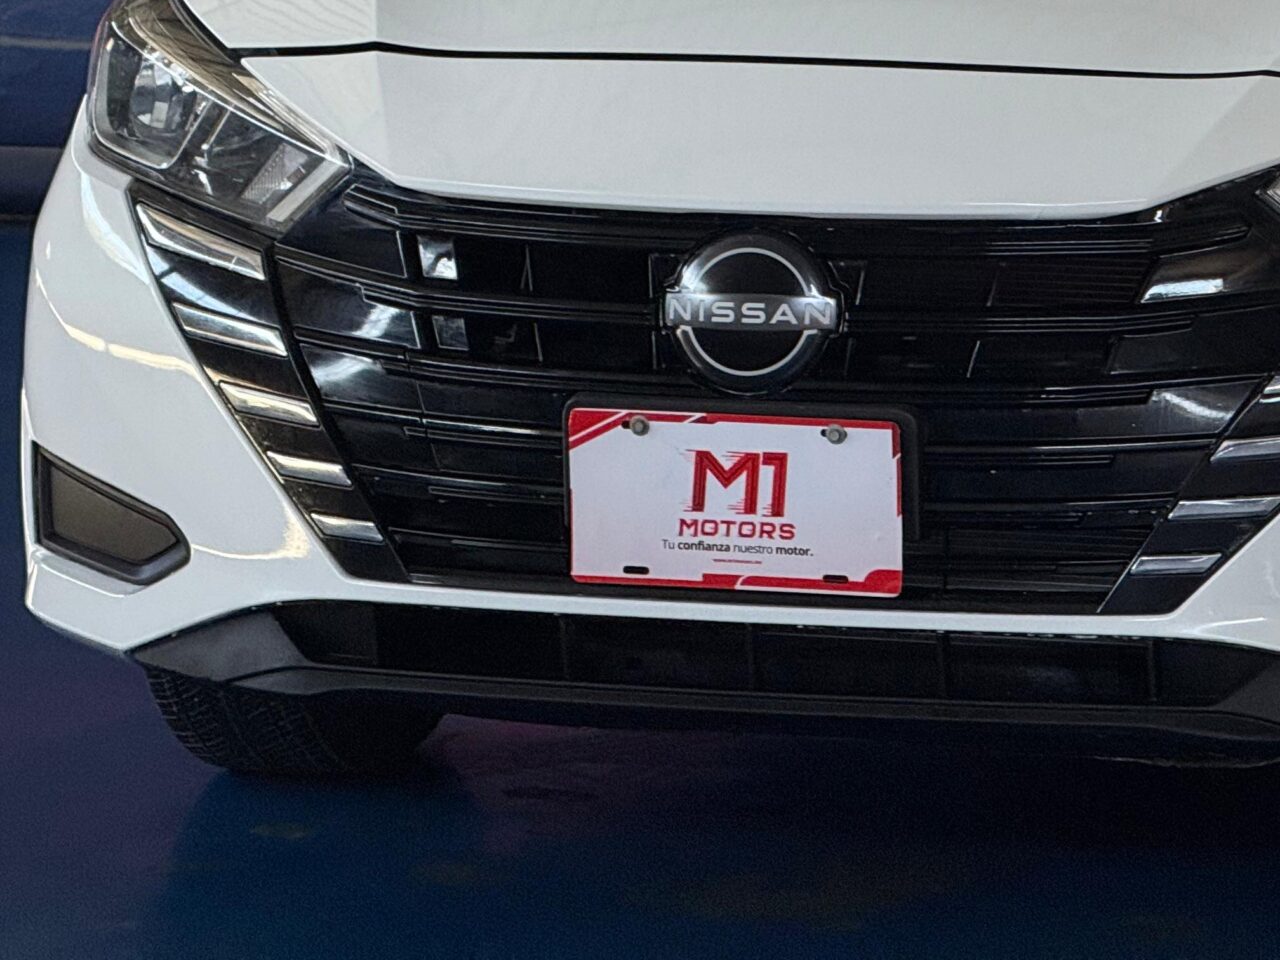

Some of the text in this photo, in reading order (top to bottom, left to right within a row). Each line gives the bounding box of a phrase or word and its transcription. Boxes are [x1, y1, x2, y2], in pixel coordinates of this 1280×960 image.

[668, 297, 832, 325] NISSAN
[681, 449, 789, 518] M1
[678, 518, 796, 540] MOTORS
[662, 539, 814, 557] Tu confianza nuestro motor.
